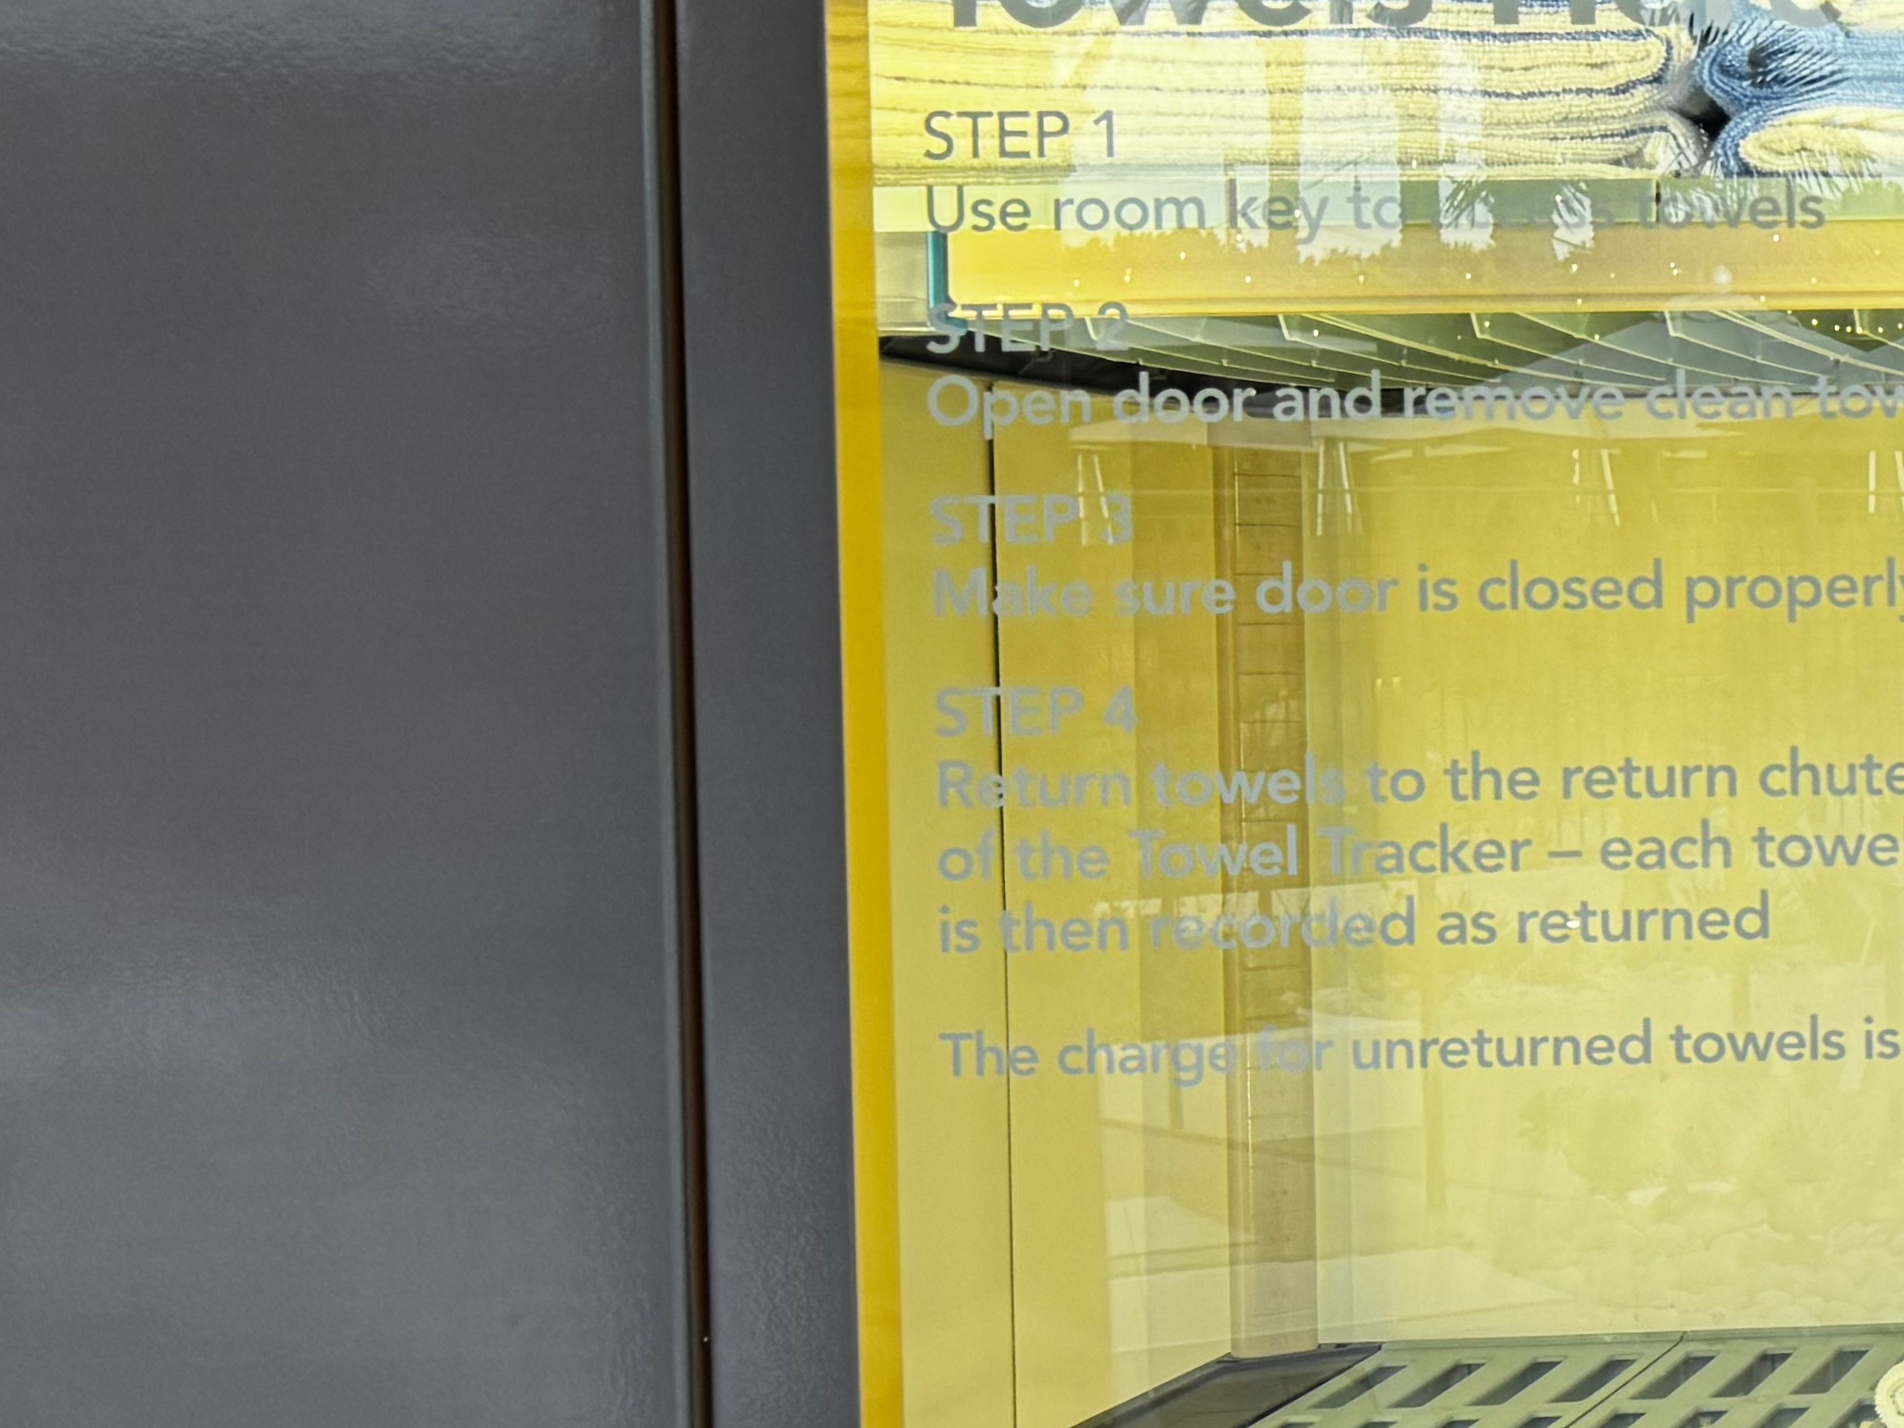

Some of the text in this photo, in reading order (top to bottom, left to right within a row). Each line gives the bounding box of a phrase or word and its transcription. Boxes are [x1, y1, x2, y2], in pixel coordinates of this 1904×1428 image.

[923, 109, 1117, 162] STEP 1
[926, 183, 1032, 233] Use
[1053, 194, 1207, 232] room
[1229, 178, 1330, 246] key
[1346, 183, 1409, 232] to
[1638, 180, 1826, 232] towels
[926, 301, 1130, 355] STEP 2
[926, 374, 1092, 440] Open
[1112, 371, 1257, 425] door
[1272, 368, 1383, 423] and
[1403, 380, 1626, 422] remove
[1645, 367, 1789, 421] clean
[929, 493, 1134, 547] STEP 3
[929, 565, 1094, 619] Make
[1114, 575, 1237, 617] sure
[1255, 560, 1399, 615] door
[1417, 562, 1460, 613] is
[1477, 557, 1664, 612] closed
[934, 684, 1138, 738] STEP 4
[935, 759, 1133, 811] Return
[1150, 751, 1347, 807] towels
[1365, 757, 1426, 804] to
[1443, 749, 1541, 803] the
[1560, 756, 1739, 801] return
[937, 826, 999, 883] of
[1011, 828, 1110, 882] the
[1129, 823, 1299, 879] Towel
[1315, 821, 1534, 877] Tracker
[1600, 818, 1733, 872] each
[939, 889, 1771, 955] is then recorded as returned
[938, 1028, 1040, 1079] The
[1056, 1026, 1238, 1089] charge
[1253, 1024, 1333, 1074] for
[1351, 1017, 1653, 1072] unreturned
[1668, 1013, 1847, 1065] towels
[1862, 1015, 1902, 1062] is
